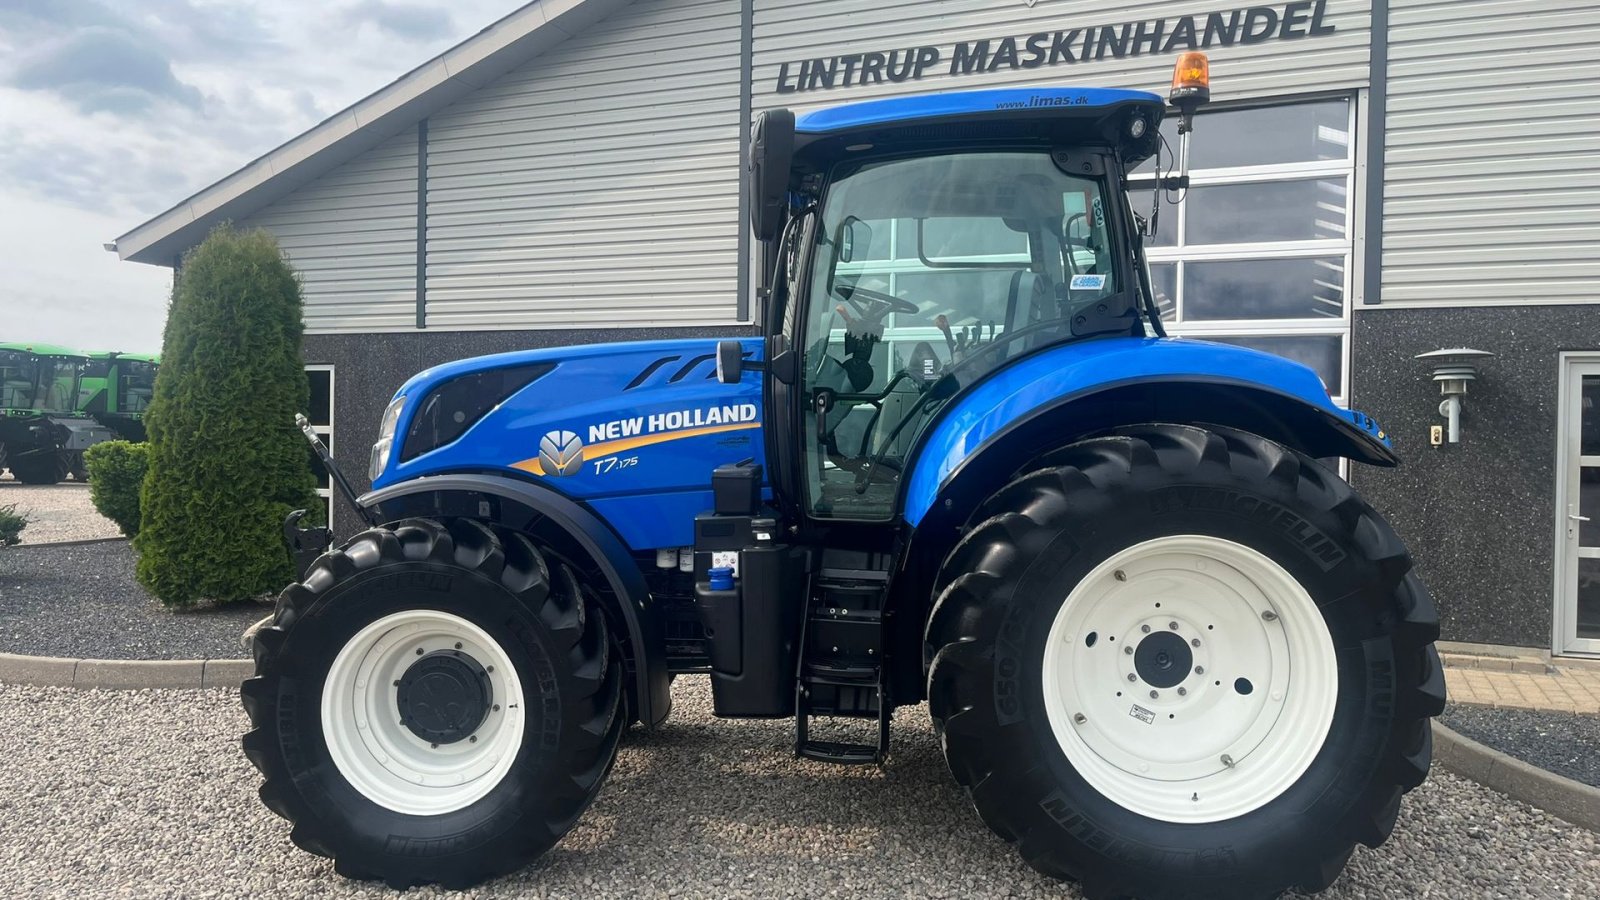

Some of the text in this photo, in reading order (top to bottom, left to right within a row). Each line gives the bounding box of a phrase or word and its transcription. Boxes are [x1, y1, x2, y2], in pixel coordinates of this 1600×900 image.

[776, 0, 1336, 94] LINTRUP MASKINHANDEL
[995, 95, 1089, 110] www.limas.dk
[588, 403, 757, 443] NEW HOLLAND
[594, 456, 639, 476] T7.175
